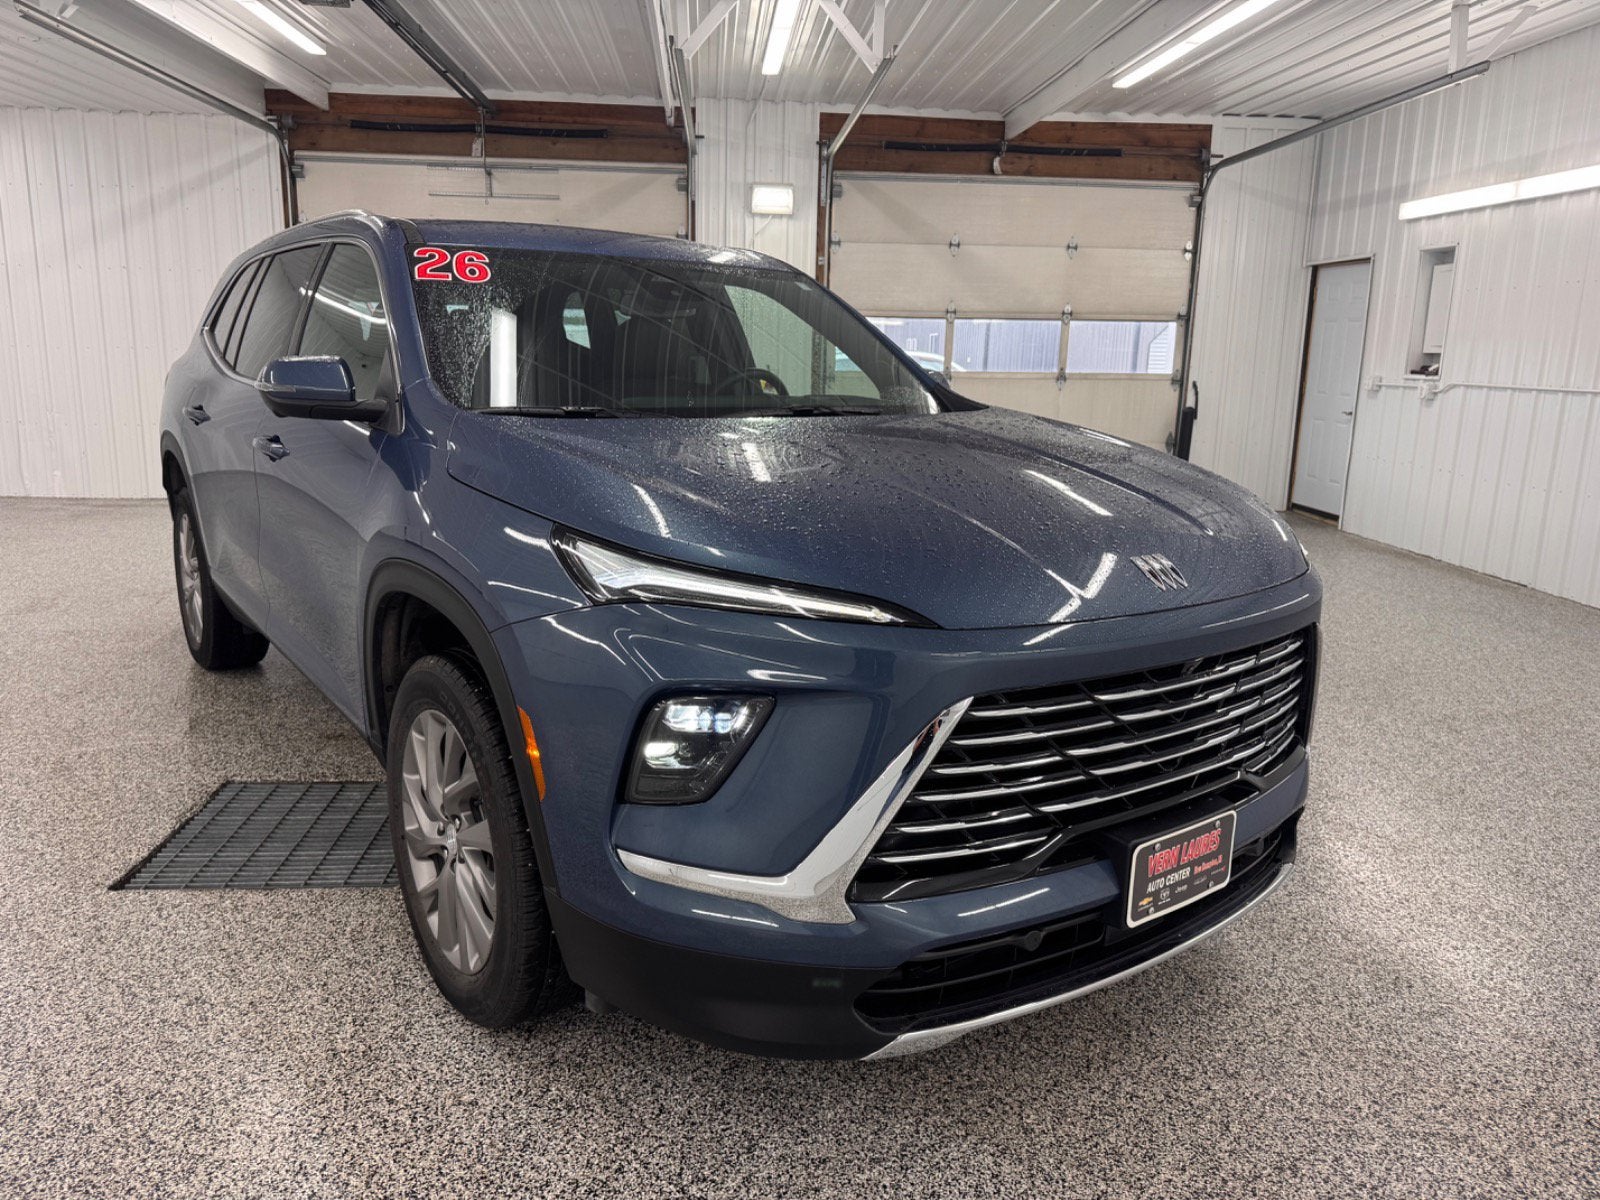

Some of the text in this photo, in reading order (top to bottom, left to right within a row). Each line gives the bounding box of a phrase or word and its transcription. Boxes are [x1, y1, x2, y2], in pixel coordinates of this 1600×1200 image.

[413, 246, 491, 283] 26
[1148, 845, 1181, 877] VERN
[1147, 877, 1165, 894] AUTO
[1166, 866, 1190, 885] CENTER
